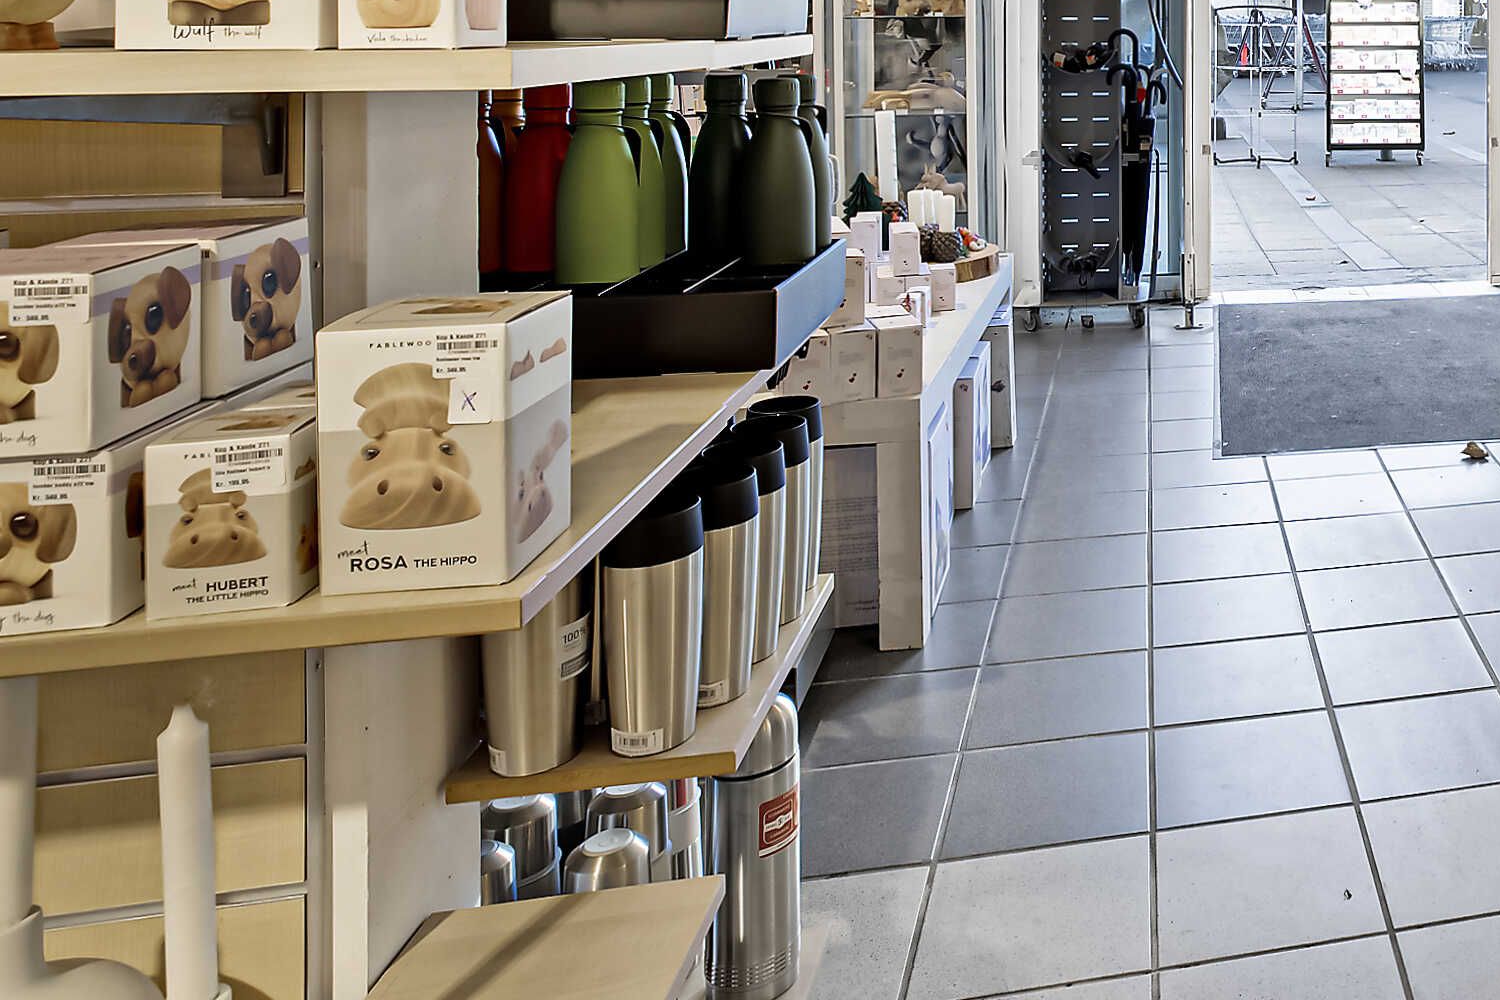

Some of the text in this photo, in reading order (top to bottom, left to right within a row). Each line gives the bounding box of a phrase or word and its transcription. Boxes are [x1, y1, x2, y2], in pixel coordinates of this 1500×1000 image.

[173, 16, 217, 42] Wulf
[13, 279, 27, 287] Kop
[236, 443, 256, 451] Kande
[337, 539, 369, 559] meet
[350, 555, 478, 573] ROSA THE HIPPO
[172, 578, 197, 592] meet
[206, 576, 269, 593] HUBERT
[186, 588, 269, 605] THE LITTLE HIPPO
[33, 609, 56, 624] dog
